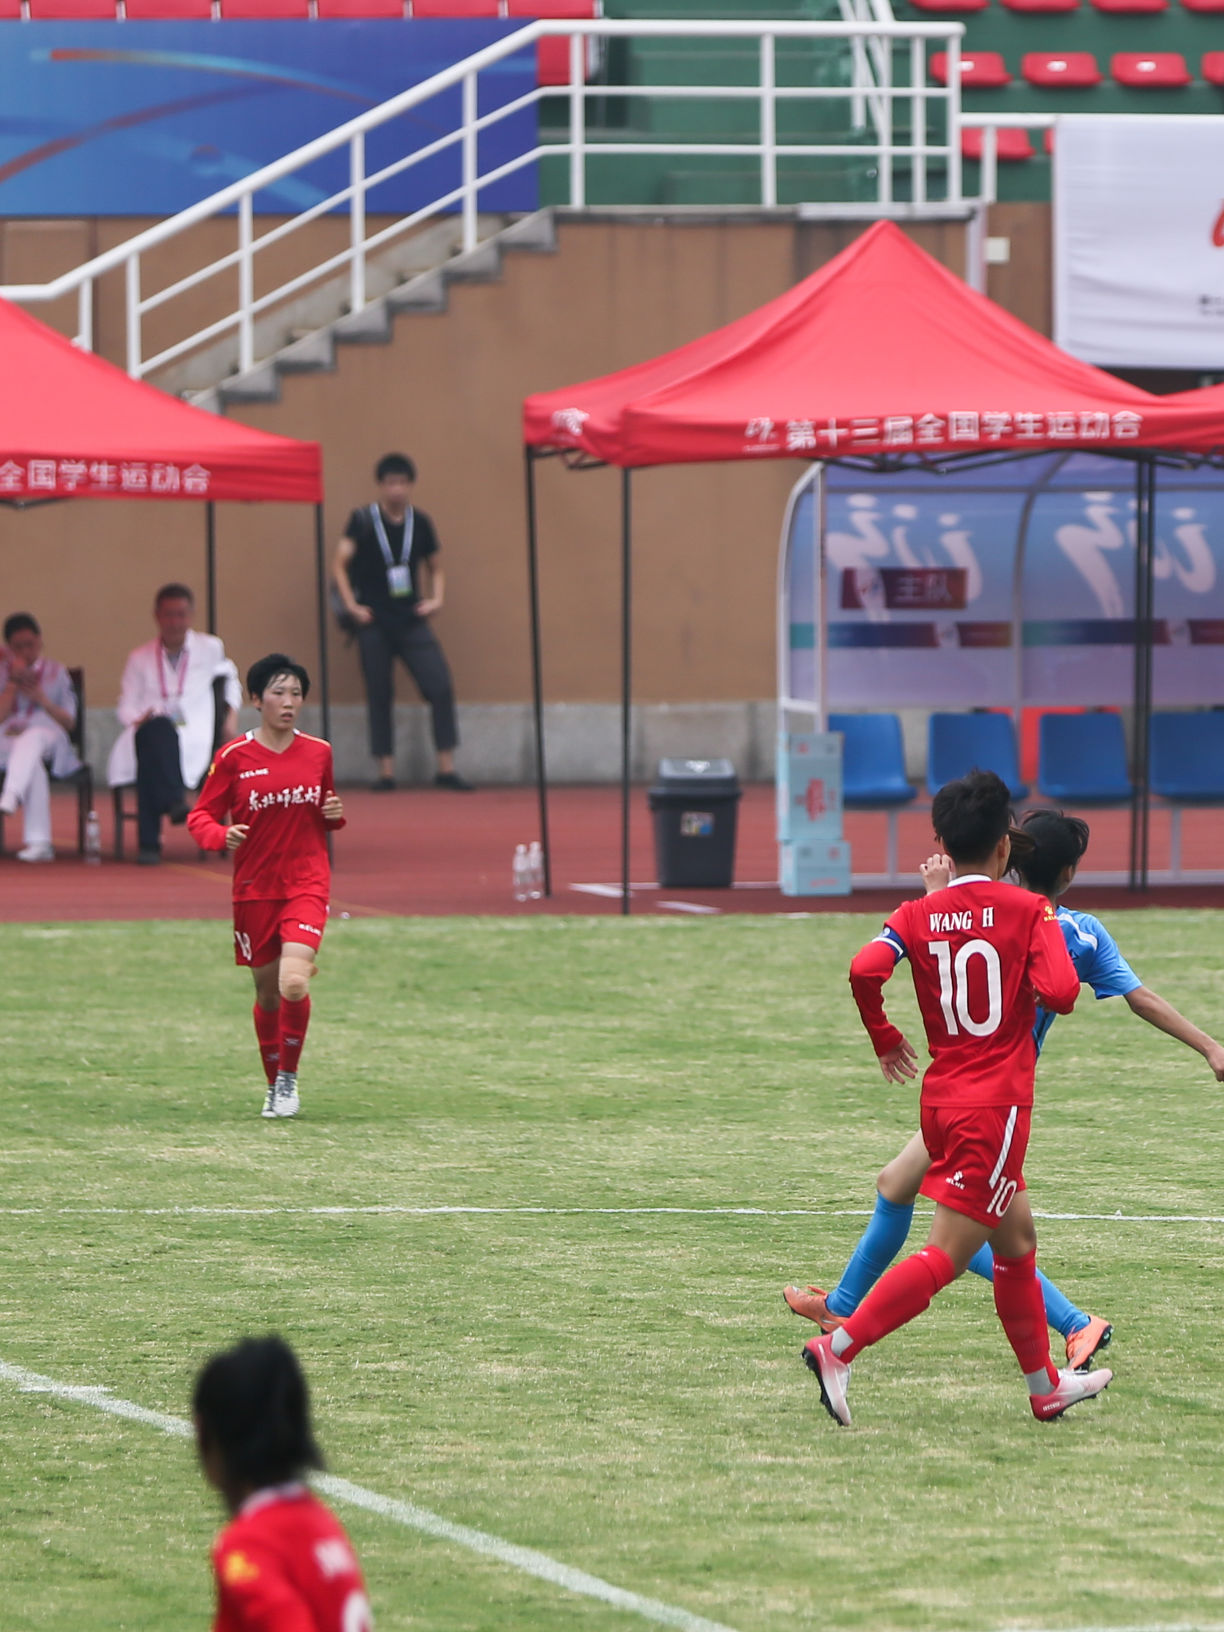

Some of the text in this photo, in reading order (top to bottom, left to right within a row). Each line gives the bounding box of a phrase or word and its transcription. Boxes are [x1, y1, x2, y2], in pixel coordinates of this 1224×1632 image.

[786, 410, 1143, 452] 第十三届全国学生运动会
[0, 459, 212, 494] 全国学生运动会
[929, 906, 994, 933] WANG H
[928, 939, 1003, 1037] 10
[986, 1176, 1018, 1217] 10
